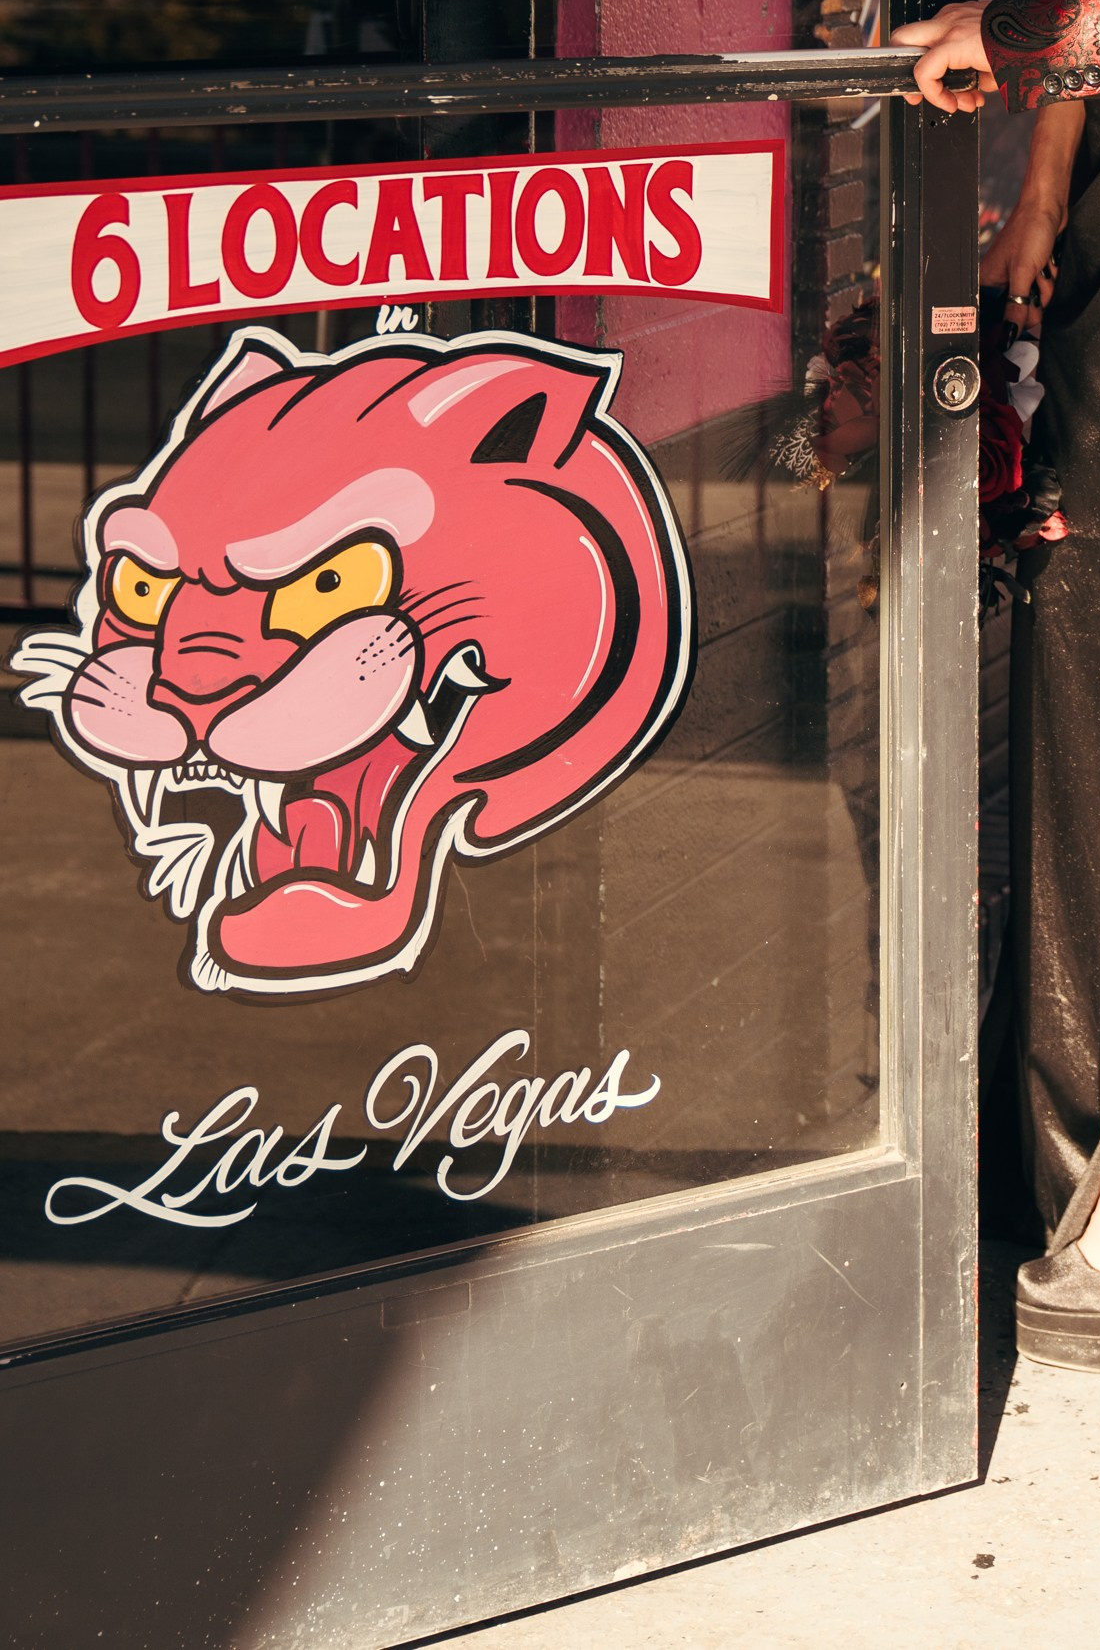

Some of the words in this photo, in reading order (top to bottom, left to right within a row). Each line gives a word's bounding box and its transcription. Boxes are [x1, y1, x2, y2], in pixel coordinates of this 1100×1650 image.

[71, 192, 142, 329] 6
[163, 159, 703, 311] LOCATIONS
[376, 304, 419, 335] in
[45, 1086, 368, 1228] Las
[366, 1029, 661, 1201] Vegas
